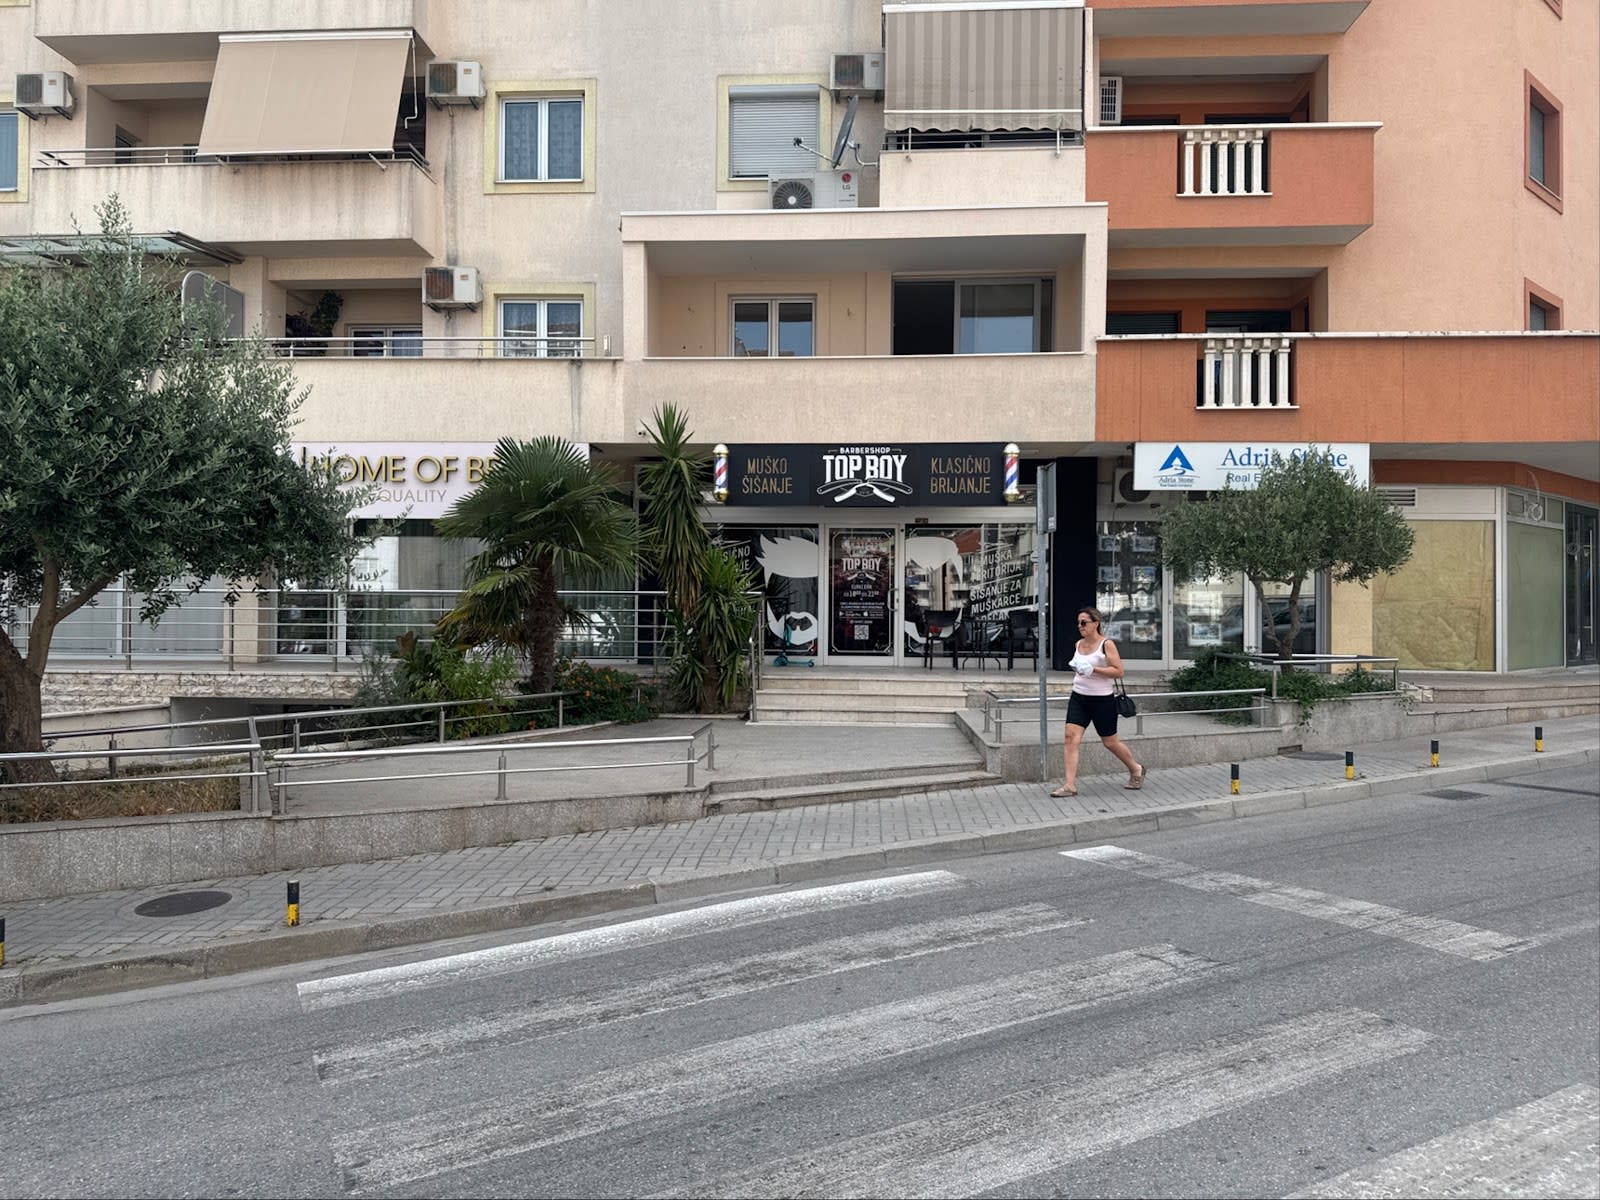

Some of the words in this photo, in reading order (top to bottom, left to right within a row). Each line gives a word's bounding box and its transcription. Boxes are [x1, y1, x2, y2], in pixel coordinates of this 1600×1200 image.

[415, 456, 459, 483] OF
[747, 456, 788, 474] MUŠKO
[822, 455, 862, 484] TOP
[865, 455, 908, 483] BOY
[931, 454, 991, 474] KLASIČNO
[742, 475, 792, 494] ŠIŠANJE
[930, 477, 991, 494] BRIJANJE
[1226, 472, 1250, 483] Real
[378, 489, 447, 503] QUALITY
[842, 558, 861, 571] TOP
[862, 558, 882, 571] BOY
[1010, 579, 1021, 592] ZA
